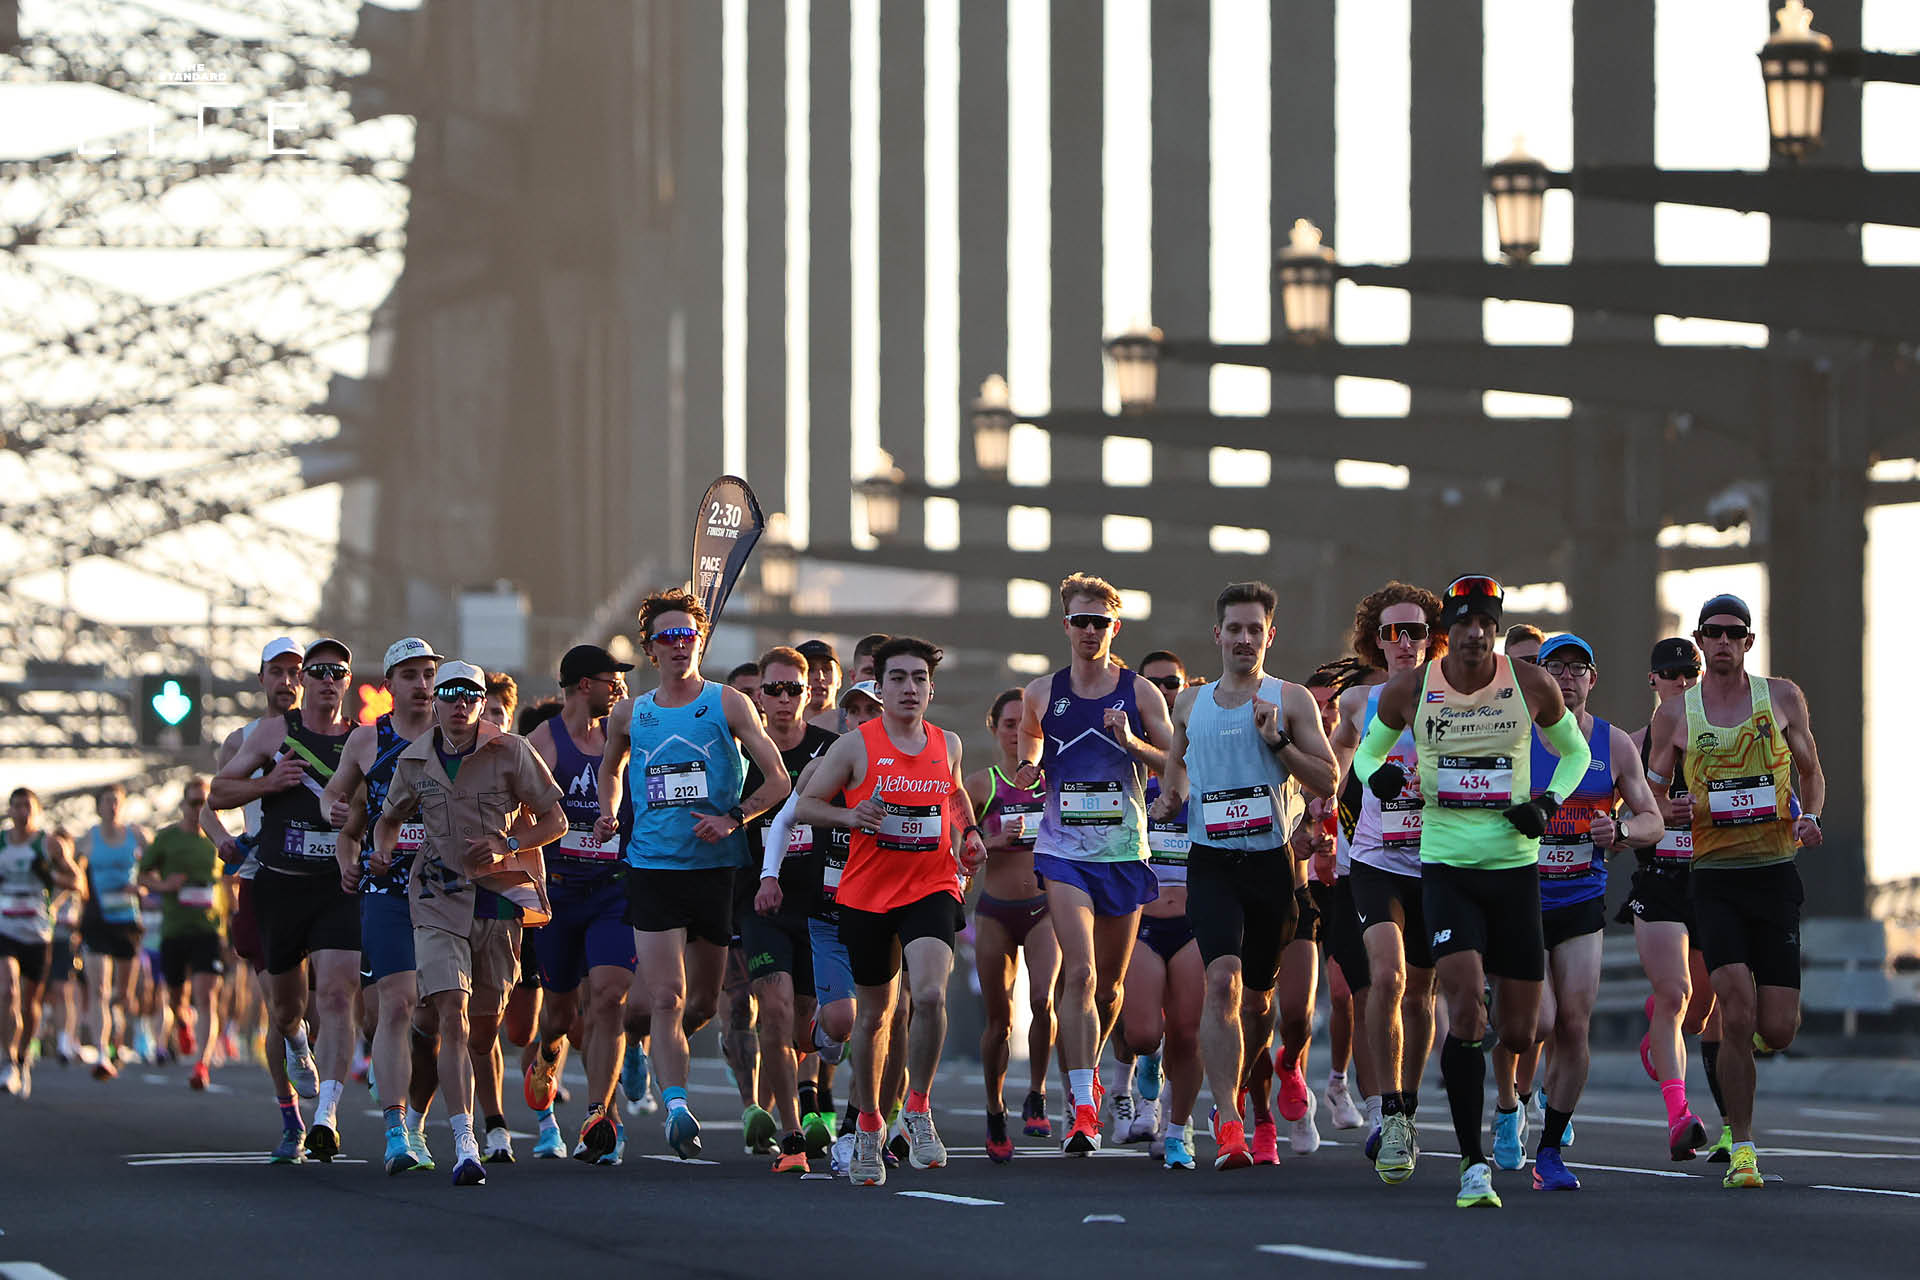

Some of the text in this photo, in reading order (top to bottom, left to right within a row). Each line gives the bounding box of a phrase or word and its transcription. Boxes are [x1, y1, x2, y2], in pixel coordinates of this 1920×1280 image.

[708, 501, 742, 527] 2:30
[706, 527, 739, 539] FINISH TIME
[700, 556, 721, 572] PACE
[1440, 705, 1503, 718] Puerto Rico
[1443, 757, 1457, 767] tcs
[650, 767, 661, 775] tcs
[877, 776, 951, 794] Melbourne
[1064, 783, 1076, 791] tcs
[1459, 775, 1490, 789] 434
[1712, 782, 1724, 790] tcs
[674, 786, 698, 798] 2121
[1206, 793, 1219, 801] tcs
[1081, 797, 1102, 810] 181
[1386, 801, 1398, 810] tcs
[1731, 794, 1754, 807] 331
[886, 804, 899, 814] tcs
[1226, 804, 1249, 818] 412
[901, 821, 923, 834] 591
[1402, 815, 1424, 828] 42
[400, 828, 425, 840] 403
[1546, 822, 1575, 834] AVON
[579, 836, 602, 848] 339
[1675, 836, 1692, 848] 59
[1547, 850, 1574, 863] 452
[829, 858, 841, 868] tcs
